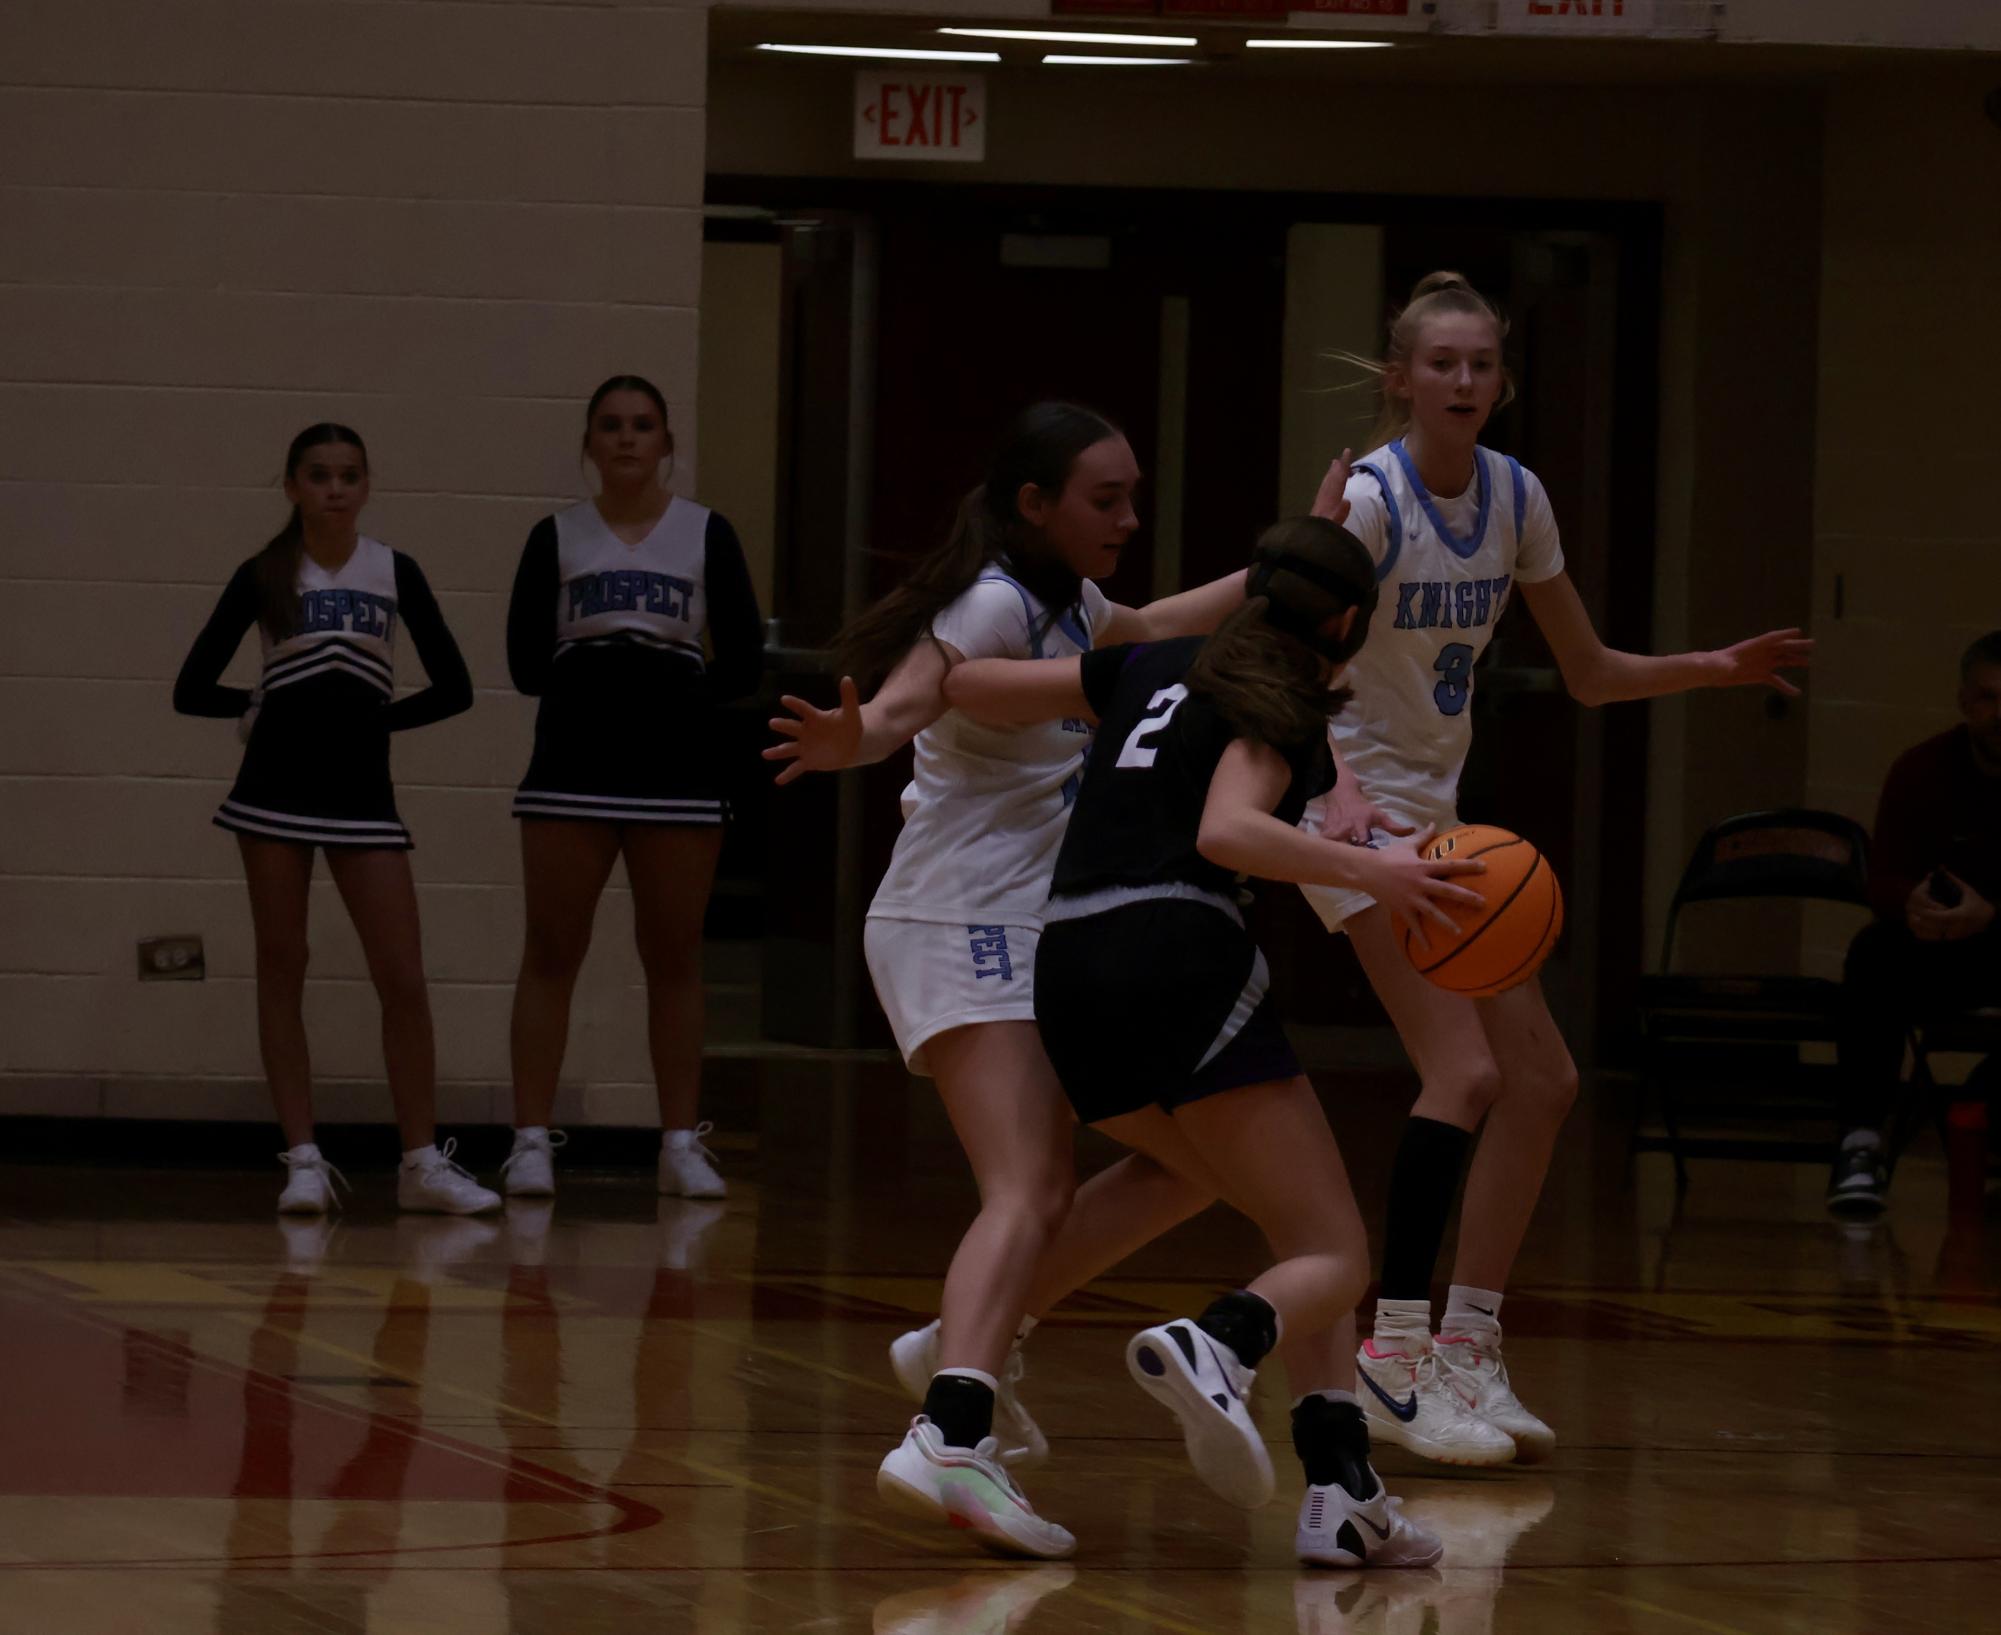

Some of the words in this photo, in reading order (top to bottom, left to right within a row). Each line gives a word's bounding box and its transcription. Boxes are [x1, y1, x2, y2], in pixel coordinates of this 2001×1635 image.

[880, 83, 967, 148] EXIT
[568, 569, 694, 622] PROSPECT
[1433, 642, 1475, 716] 3
[1114, 682, 1190, 768] 2
